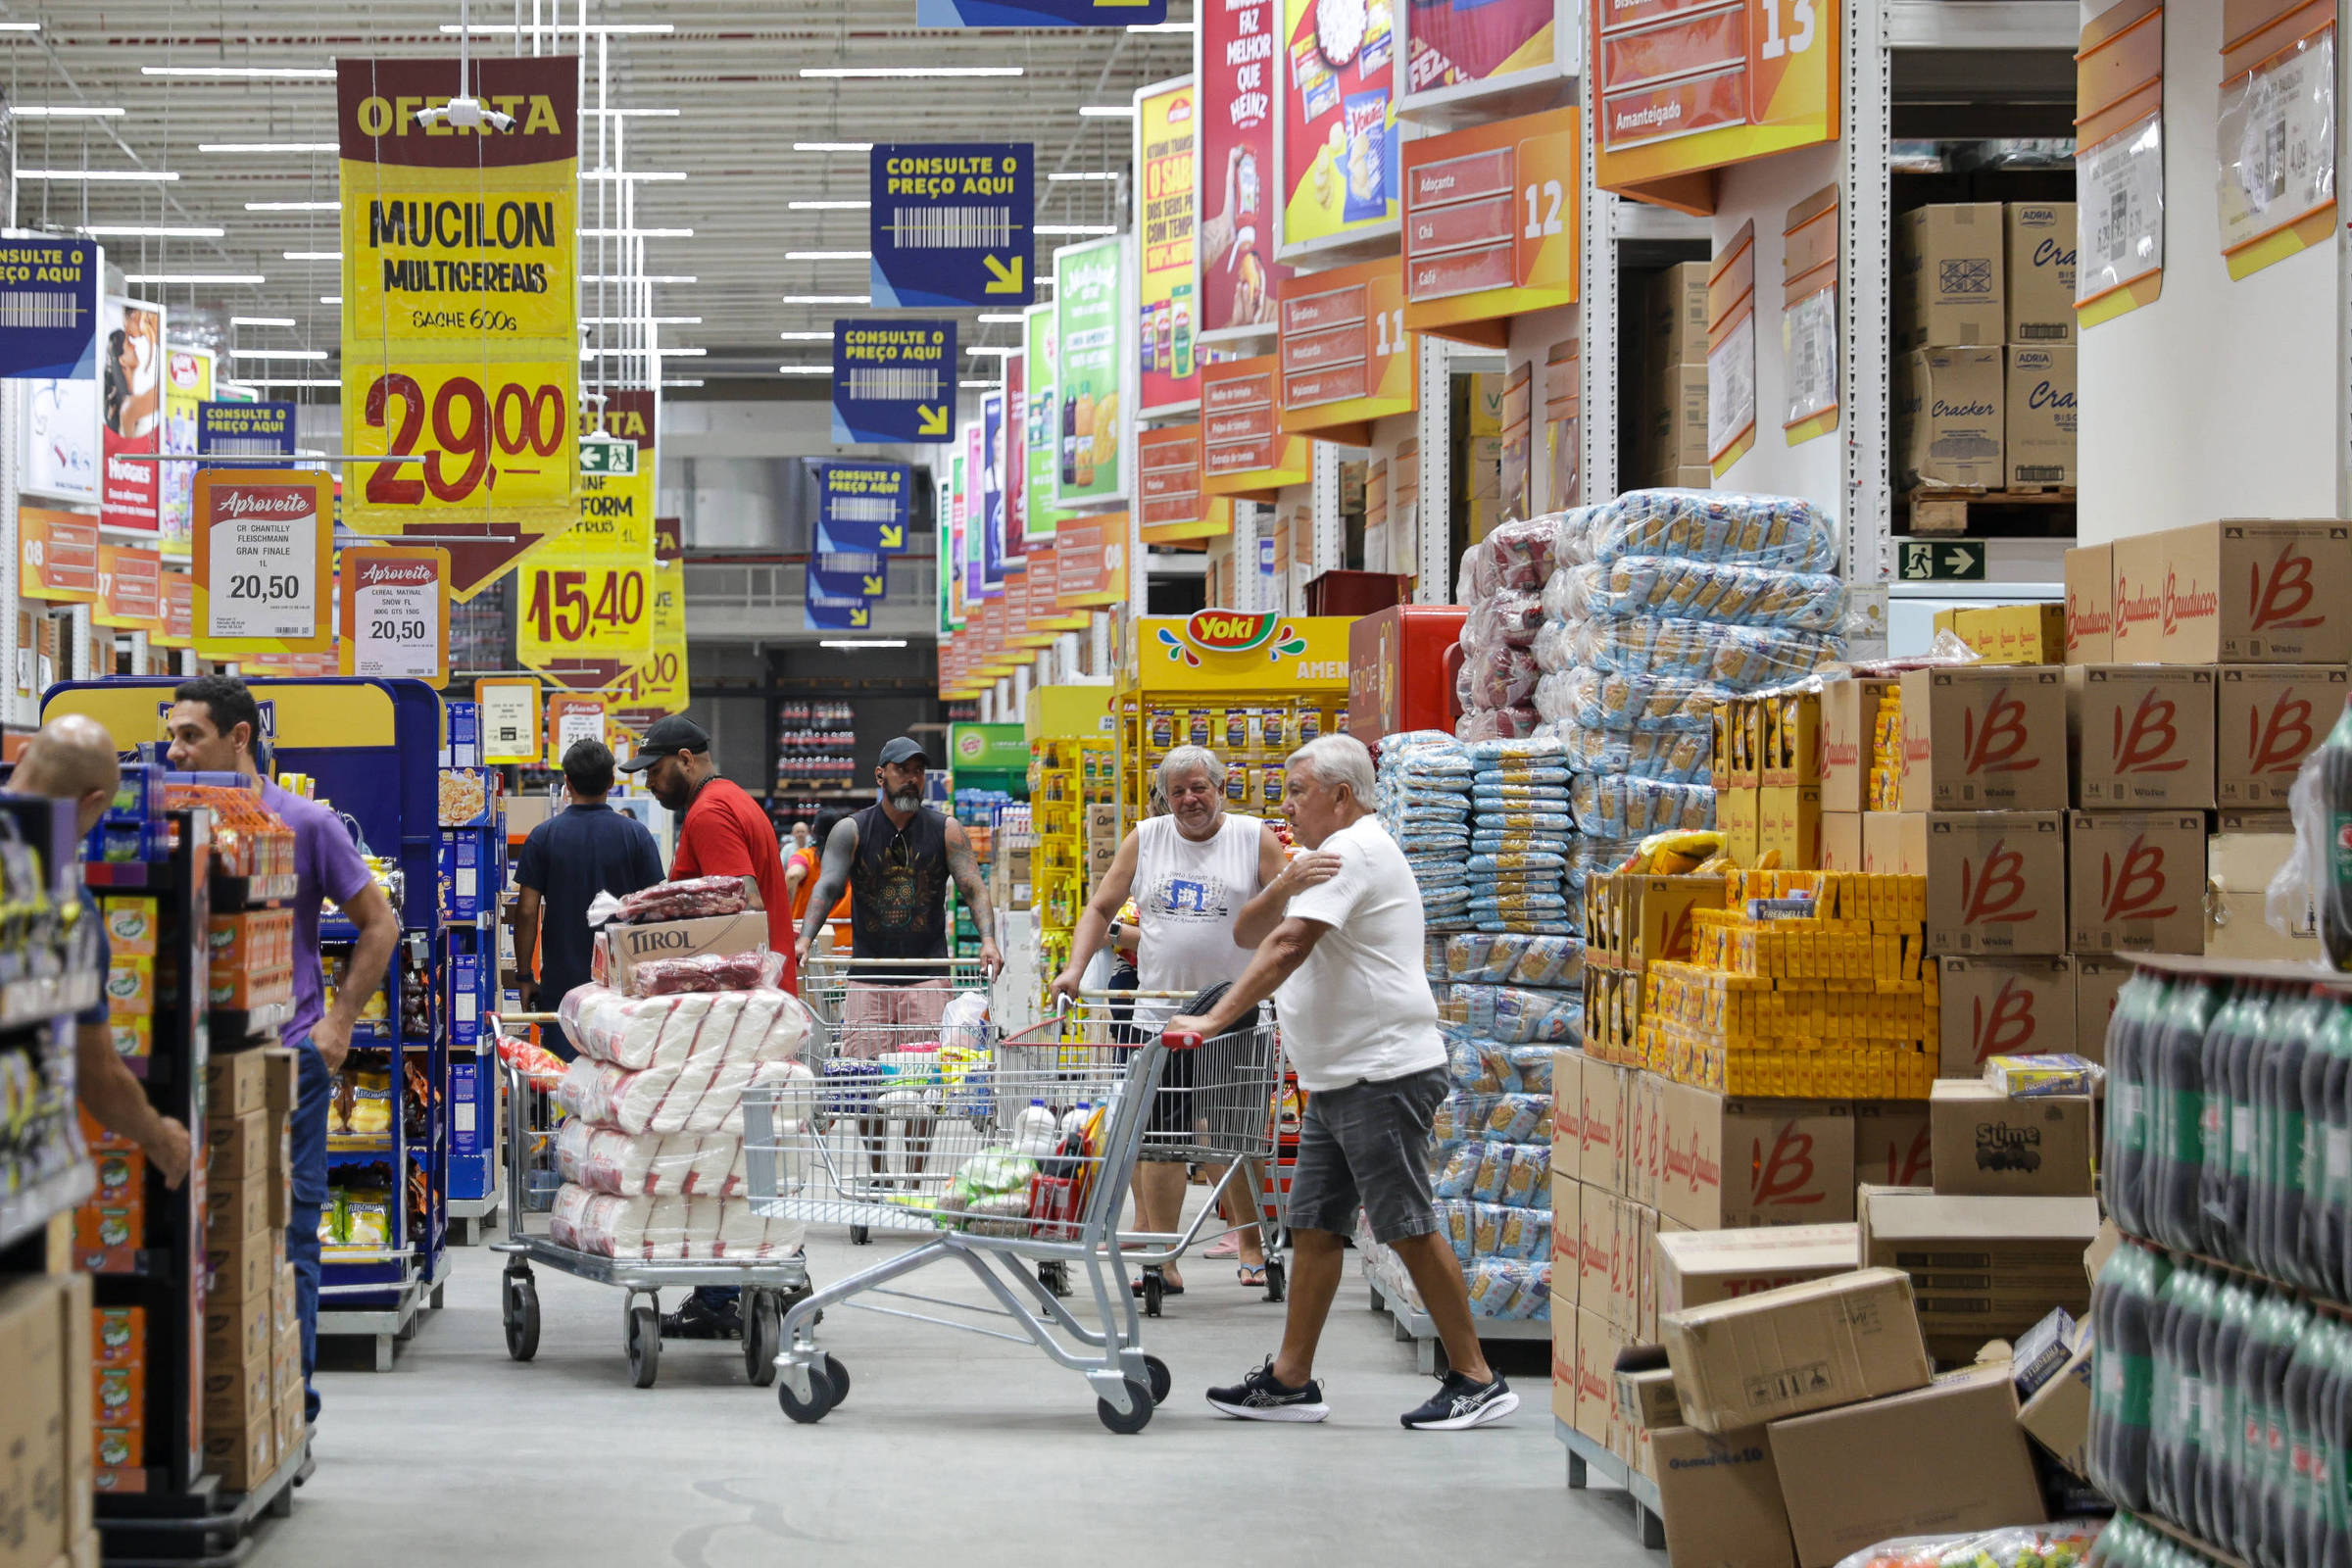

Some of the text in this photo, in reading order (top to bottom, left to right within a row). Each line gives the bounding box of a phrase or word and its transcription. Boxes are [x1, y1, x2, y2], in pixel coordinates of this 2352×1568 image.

[1239, 8, 1260, 35] FAZ
[1227, 33, 1272, 66] MELHOR
[1237, 63, 1262, 92] QUE
[1230, 91, 1269, 125] HEINZ
[1616, 101, 1682, 131] Amanteigado
[886, 157, 1017, 174] CONSULTE O
[1150, 155, 1194, 198] O SAB
[888, 177, 1014, 199] PREÇO AQUI
[1420, 173, 1456, 195] Adoçante
[1524, 179, 1562, 239] 12
[2022, 211, 2054, 220] ADRIA
[369, 200, 556, 249] MUCILON
[1418, 220, 1434, 241] Chá
[71, 250, 83, 265] O
[36, 266, 80, 283] AQUI
[384, 259, 548, 294] MULTICEREAIS
[1418, 269, 1437, 286] Café
[413, 310, 466, 328] SACHE
[845, 331, 944, 345] CONSULTE O
[1376, 308, 1406, 357] 11
[846, 346, 942, 363] PREÇO AQUI
[2019, 354, 2049, 363] ADRIA
[206, 408, 286, 420] CONSULTE O
[1932, 400, 1995, 418] Cracker
[207, 420, 284, 434] PREÇO AQUI
[366, 372, 564, 505] 29,00
[108, 458, 151, 484] HUGGIES
[829, 470, 901, 481] CONSULTE O
[829, 481, 899, 495] PREÇO AQUI
[218, 491, 309, 518] Aproveite
[237, 534, 289, 543] FLEISCHMANN
[236, 547, 291, 556] GRAN FINALE
[361, 564, 432, 584] Aproveite
[230, 574, 299, 604] 20,50
[527, 570, 644, 642] 15,40
[371, 620, 425, 643] 20,50
[1198, 615, 1255, 641] Yoki
[1763, 909, 1808, 919] FREEGELLS
[627, 930, 696, 956] TIROL
[1976, 1121, 2040, 1148] Slime
